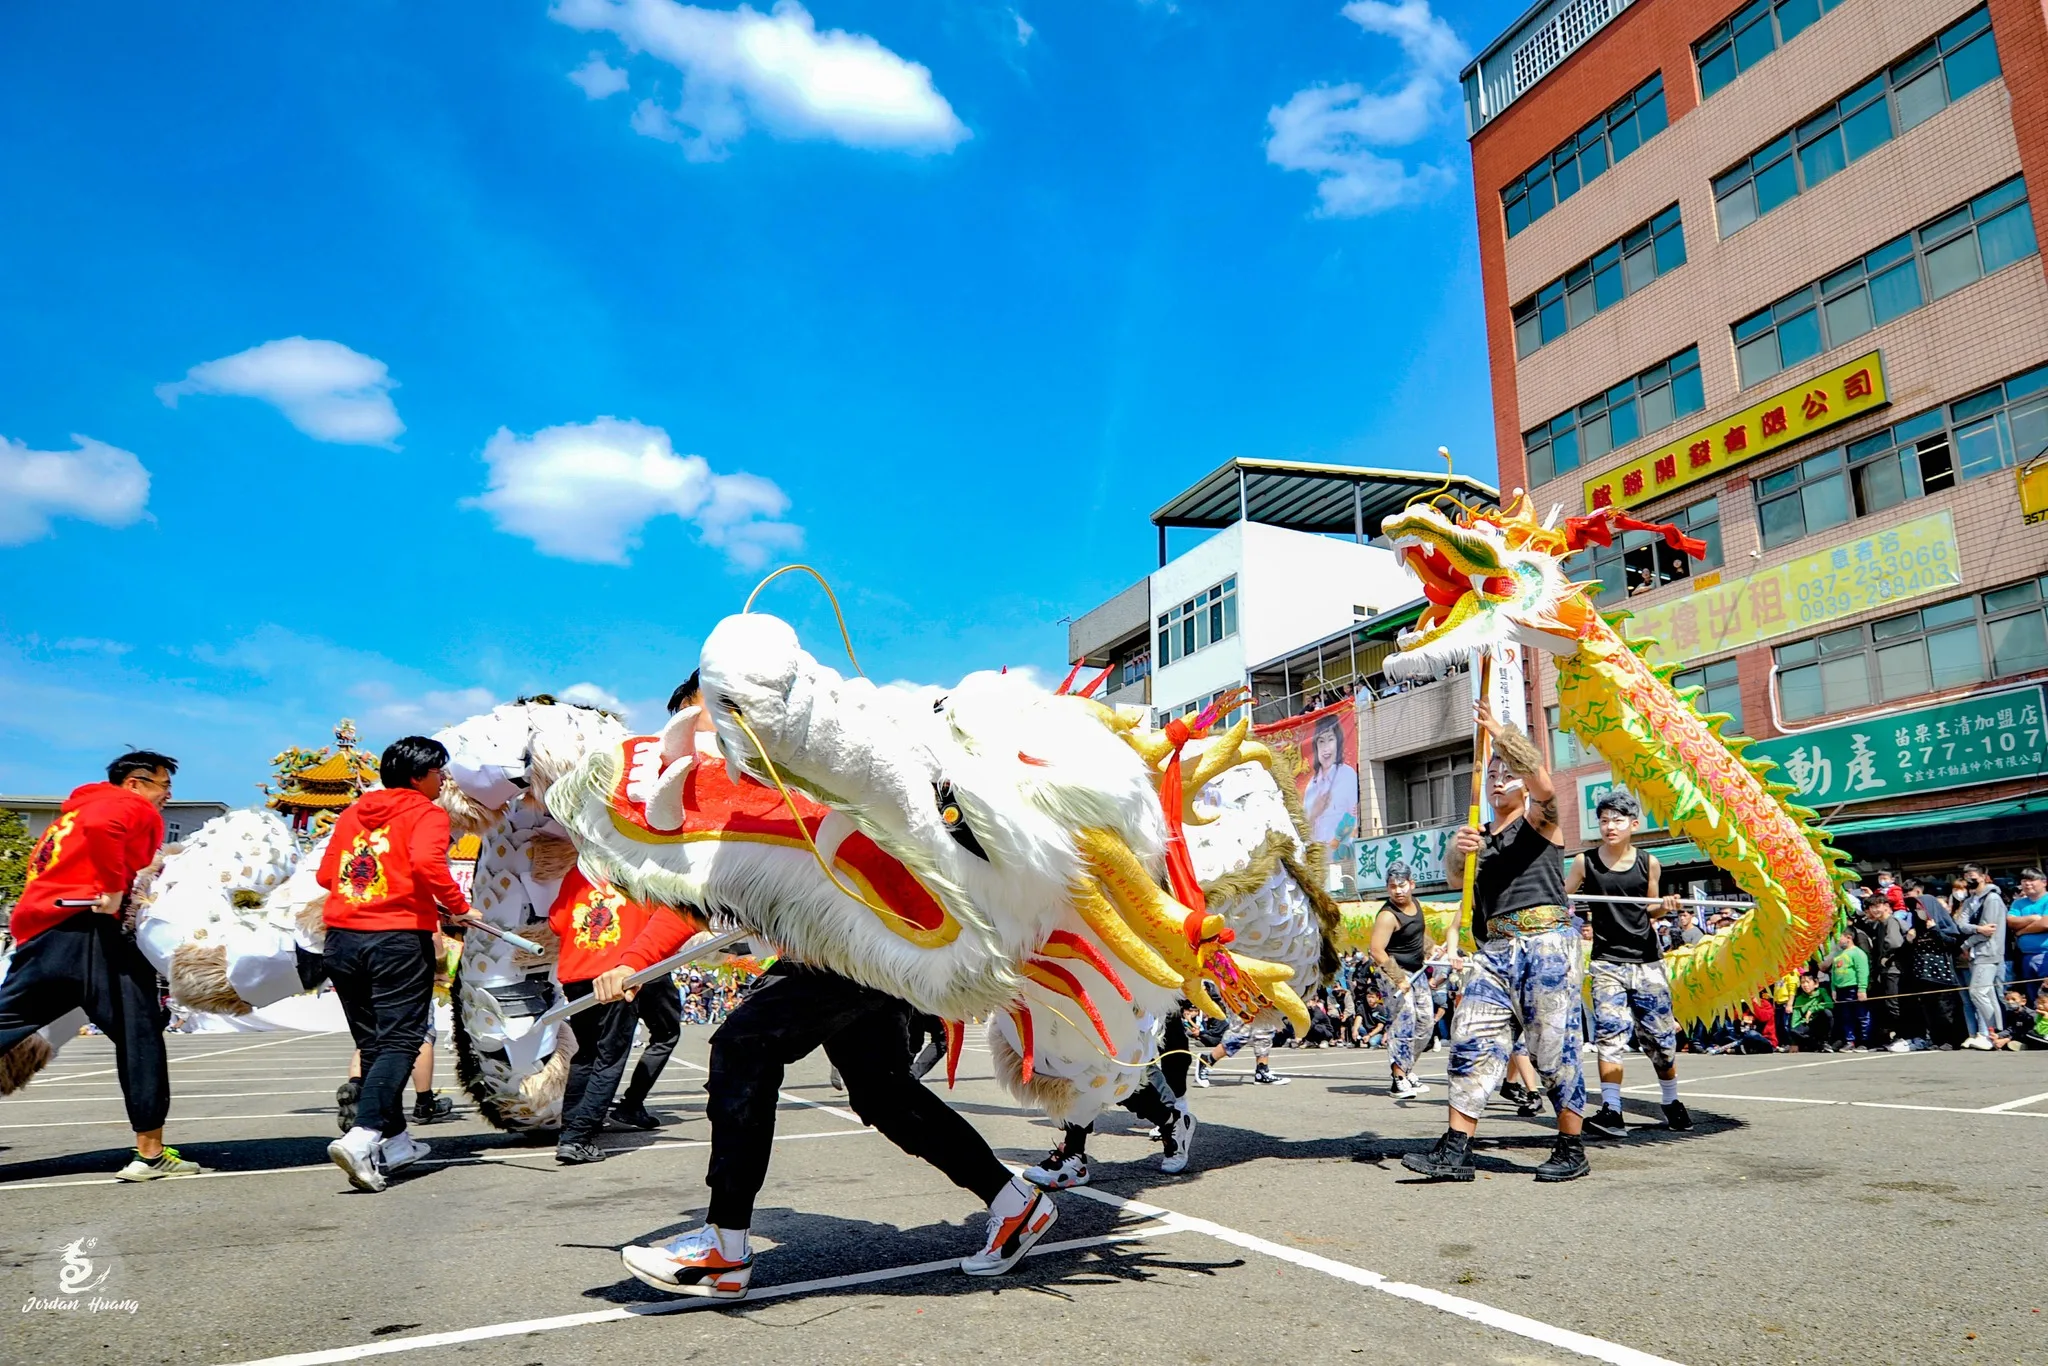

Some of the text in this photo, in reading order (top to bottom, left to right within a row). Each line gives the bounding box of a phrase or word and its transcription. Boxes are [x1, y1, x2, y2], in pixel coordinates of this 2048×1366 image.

[1797, 541, 1948, 602] 037-253066
[1752, 733, 1887, 797] 動產
[1897, 729, 2039, 768] 277-107
